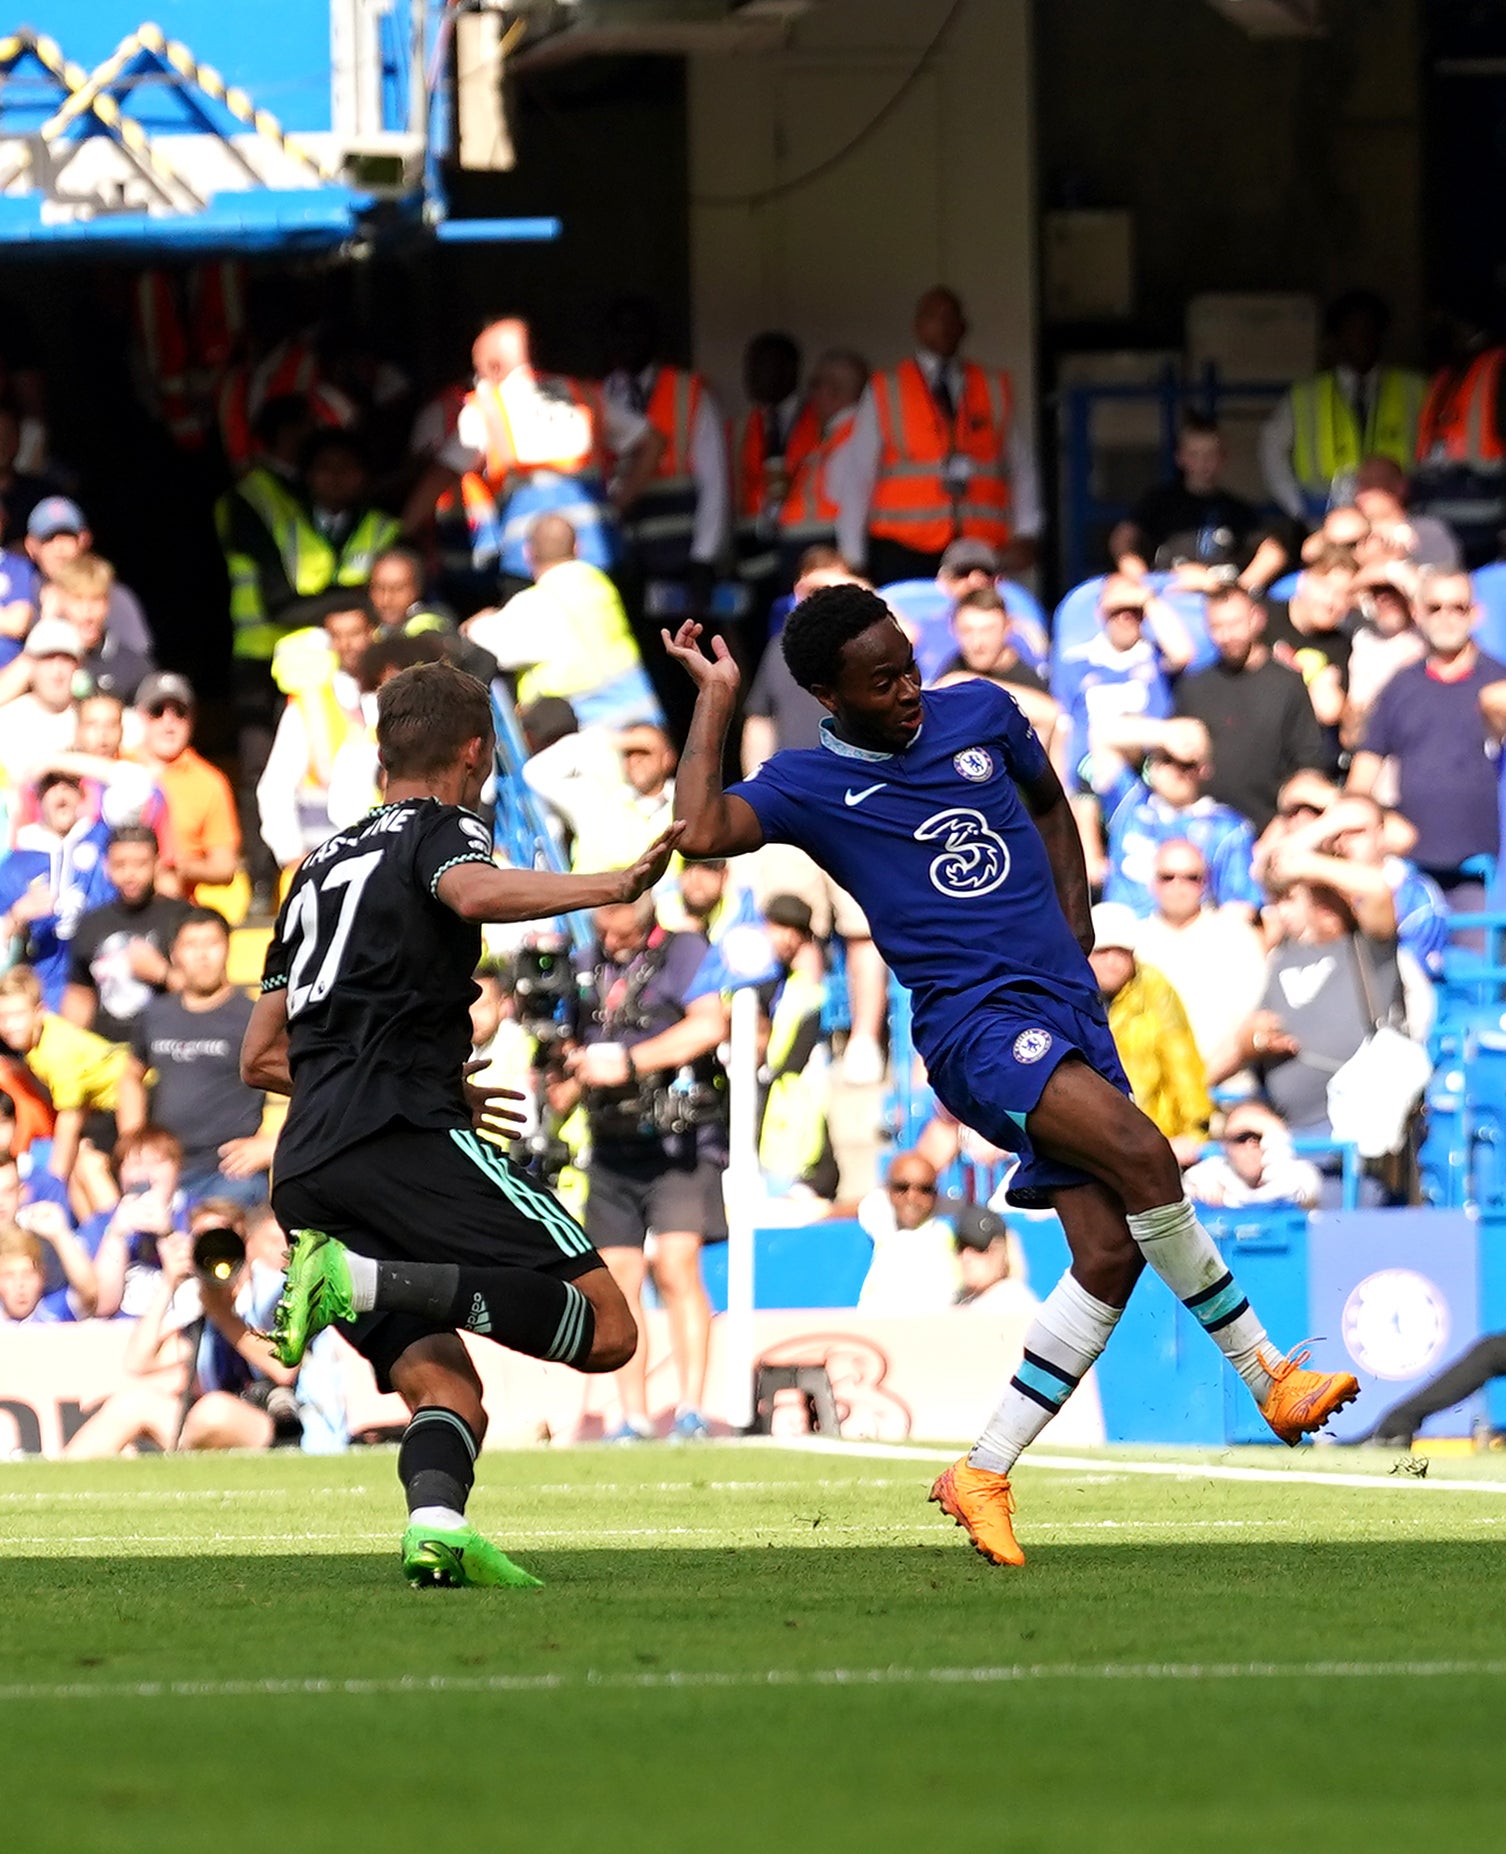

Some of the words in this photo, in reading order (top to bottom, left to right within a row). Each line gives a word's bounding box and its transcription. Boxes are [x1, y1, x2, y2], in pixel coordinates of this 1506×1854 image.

[301, 809, 417, 871] ASNE
[282, 849, 384, 1020] 27
[464, 1292, 482, 1331] adid
